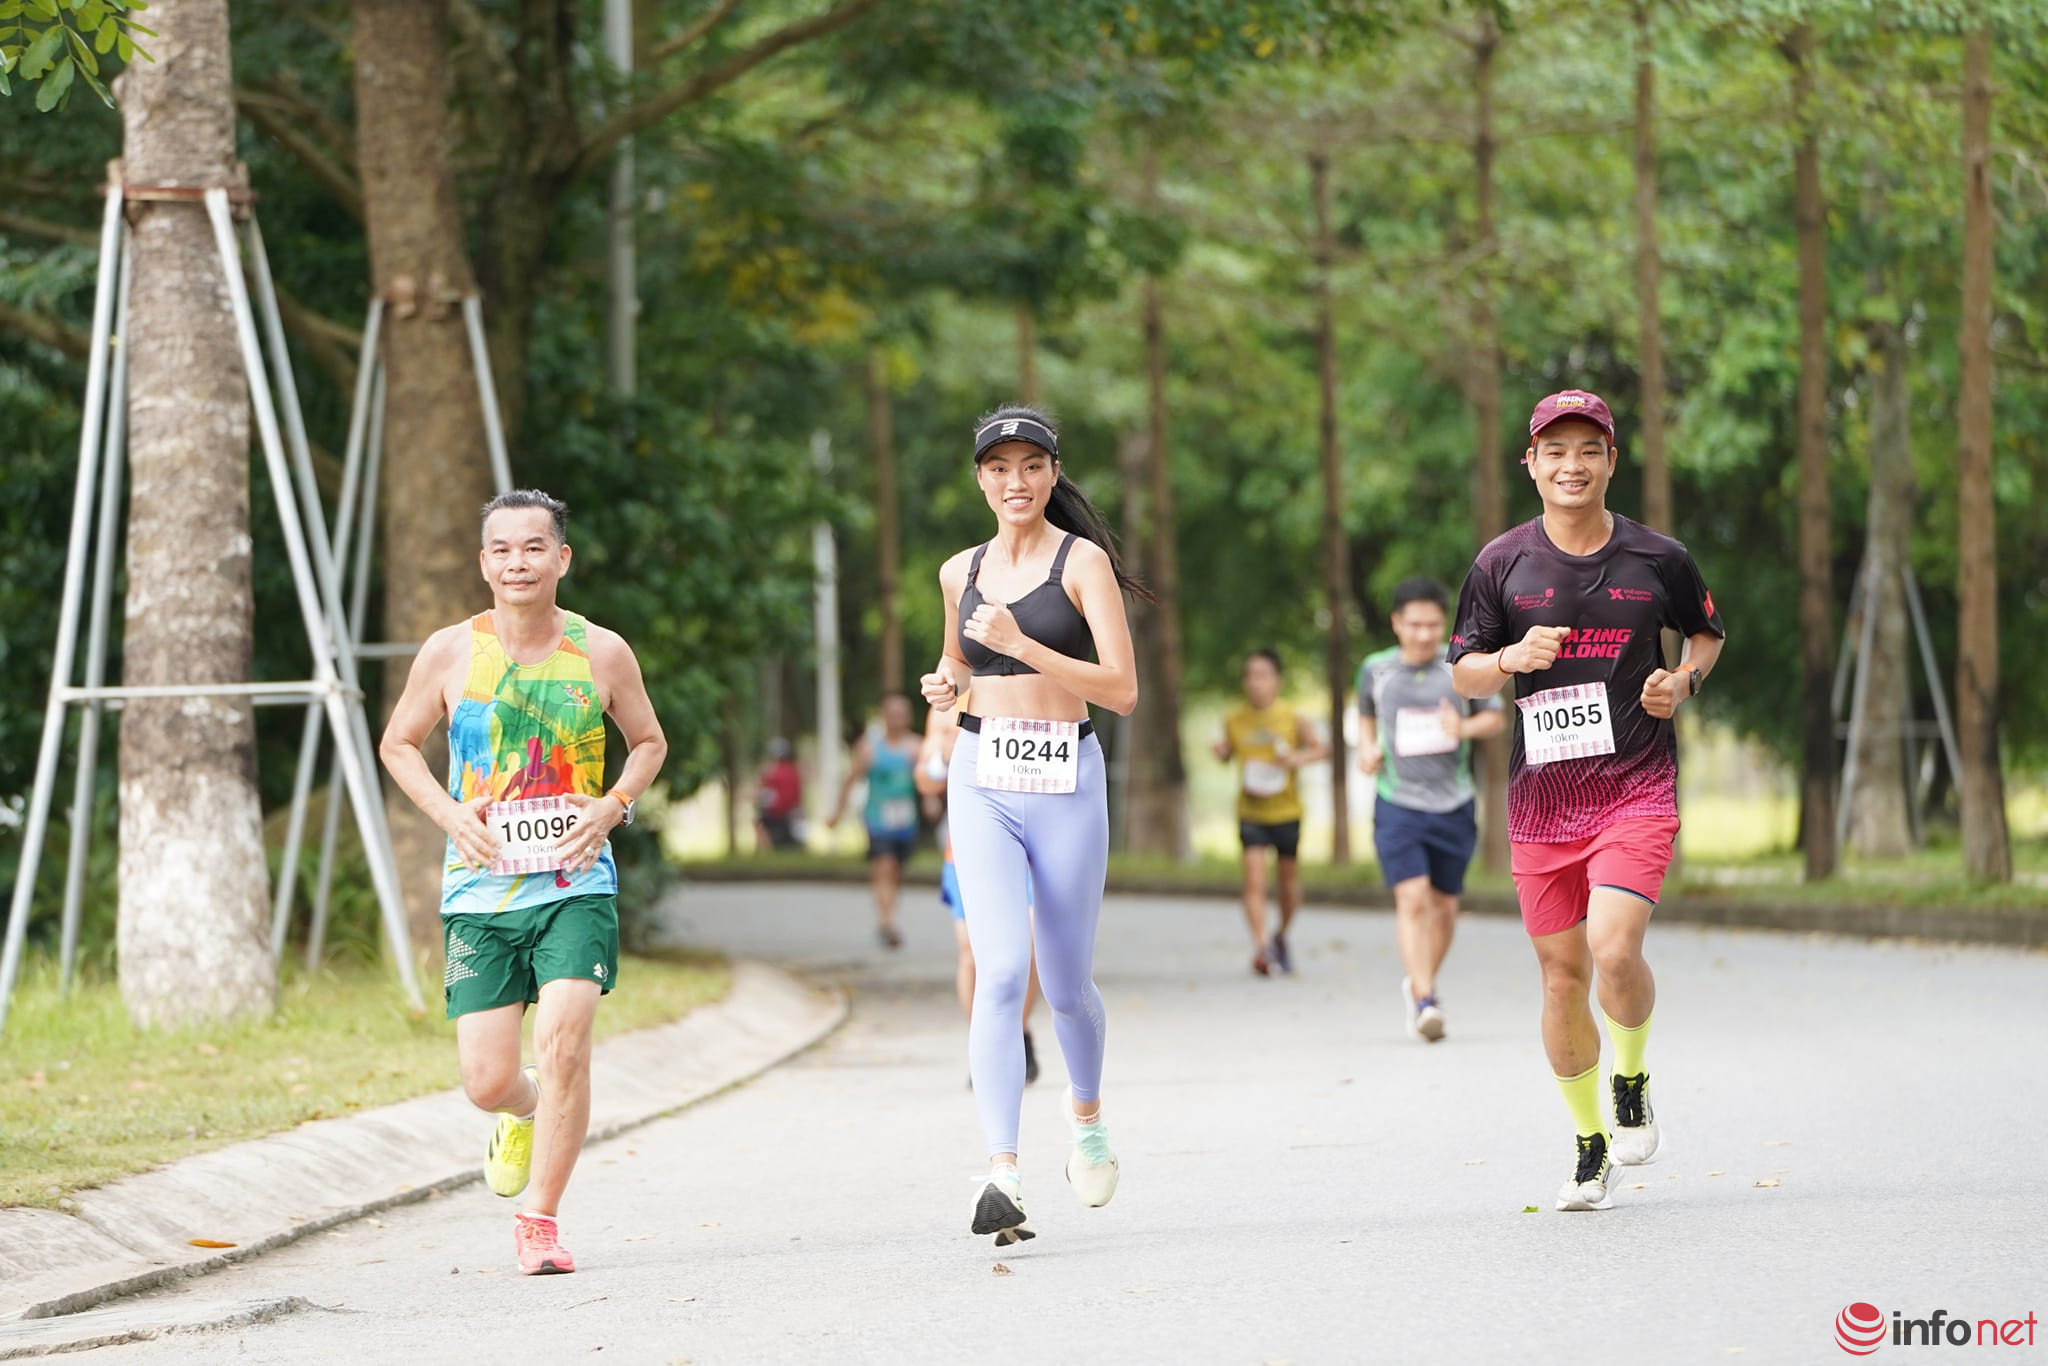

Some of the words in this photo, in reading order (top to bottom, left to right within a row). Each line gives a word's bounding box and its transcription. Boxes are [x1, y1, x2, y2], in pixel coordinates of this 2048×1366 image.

[1533, 703, 1602, 732] 10055
[1550, 733, 1579, 744] 10km
[992, 737, 1069, 762] 10244
[1012, 764, 1042, 775] 10km
